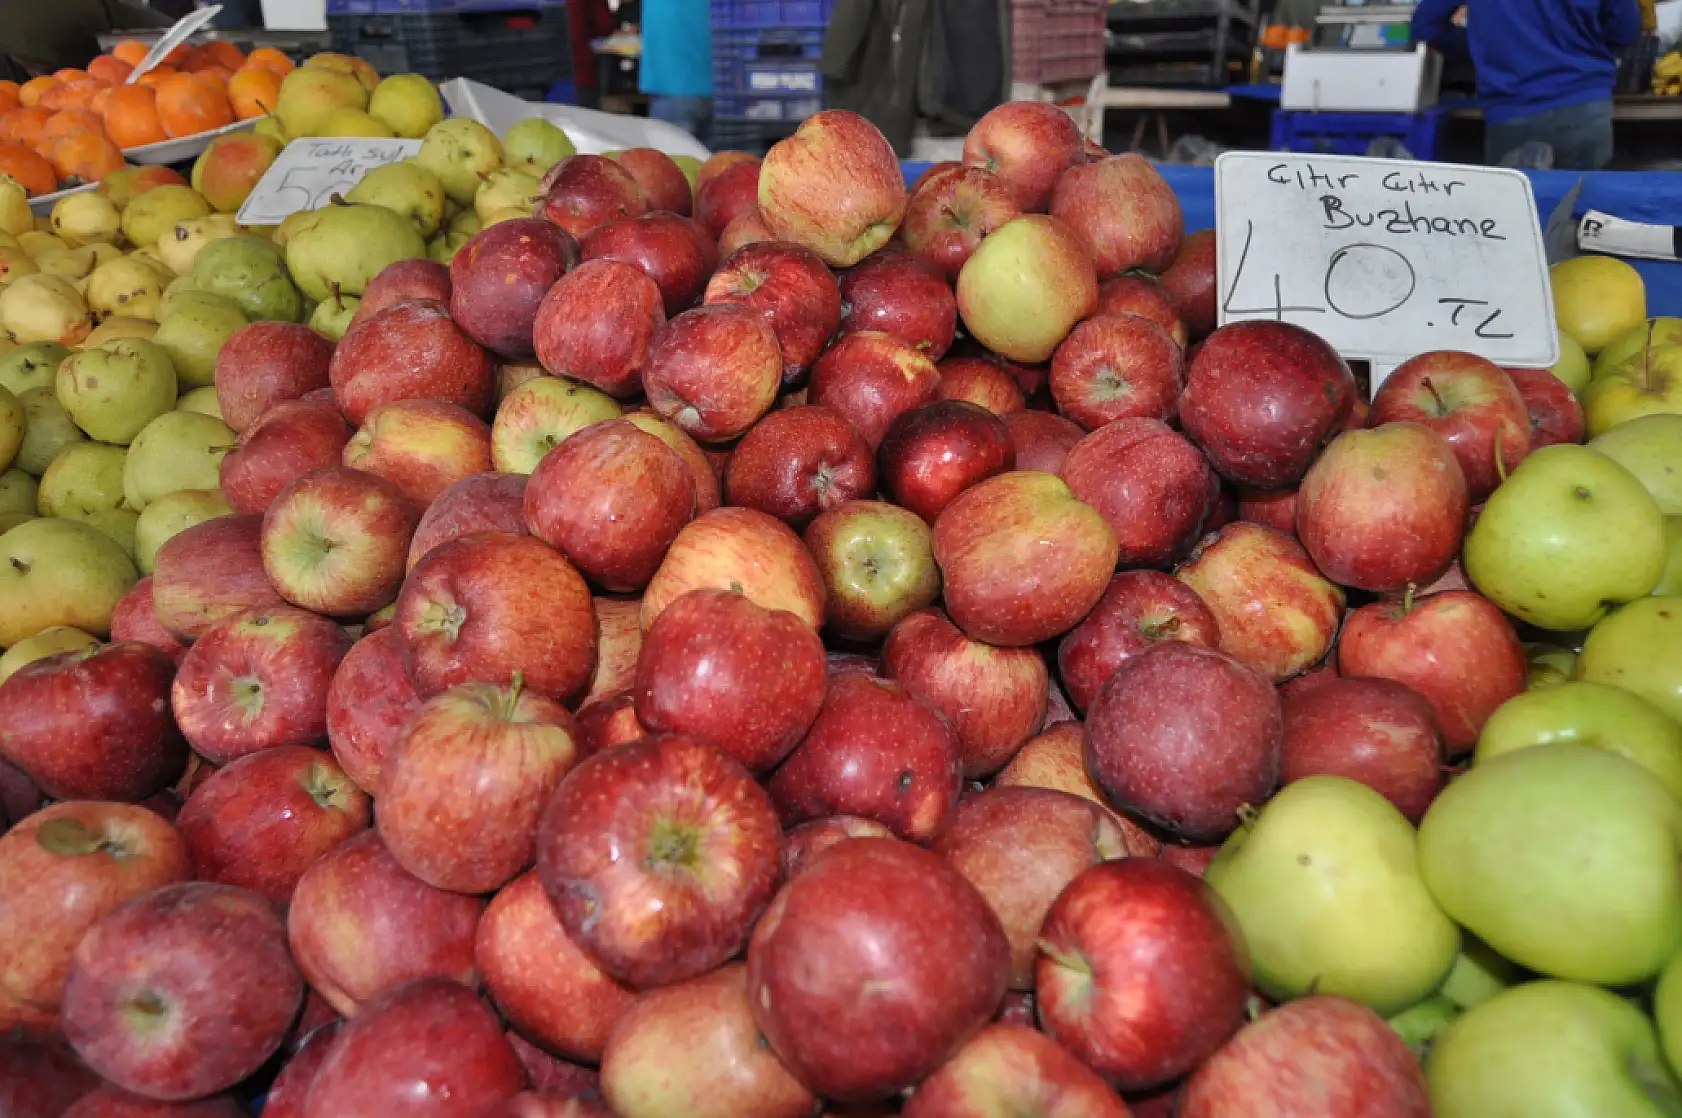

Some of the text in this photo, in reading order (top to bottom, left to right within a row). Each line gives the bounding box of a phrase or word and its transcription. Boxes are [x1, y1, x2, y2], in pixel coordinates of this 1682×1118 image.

[329, 159, 364, 177] Ar
[1318, 194, 1507, 240] Buzhane
[1223, 219, 1417, 321] 40
